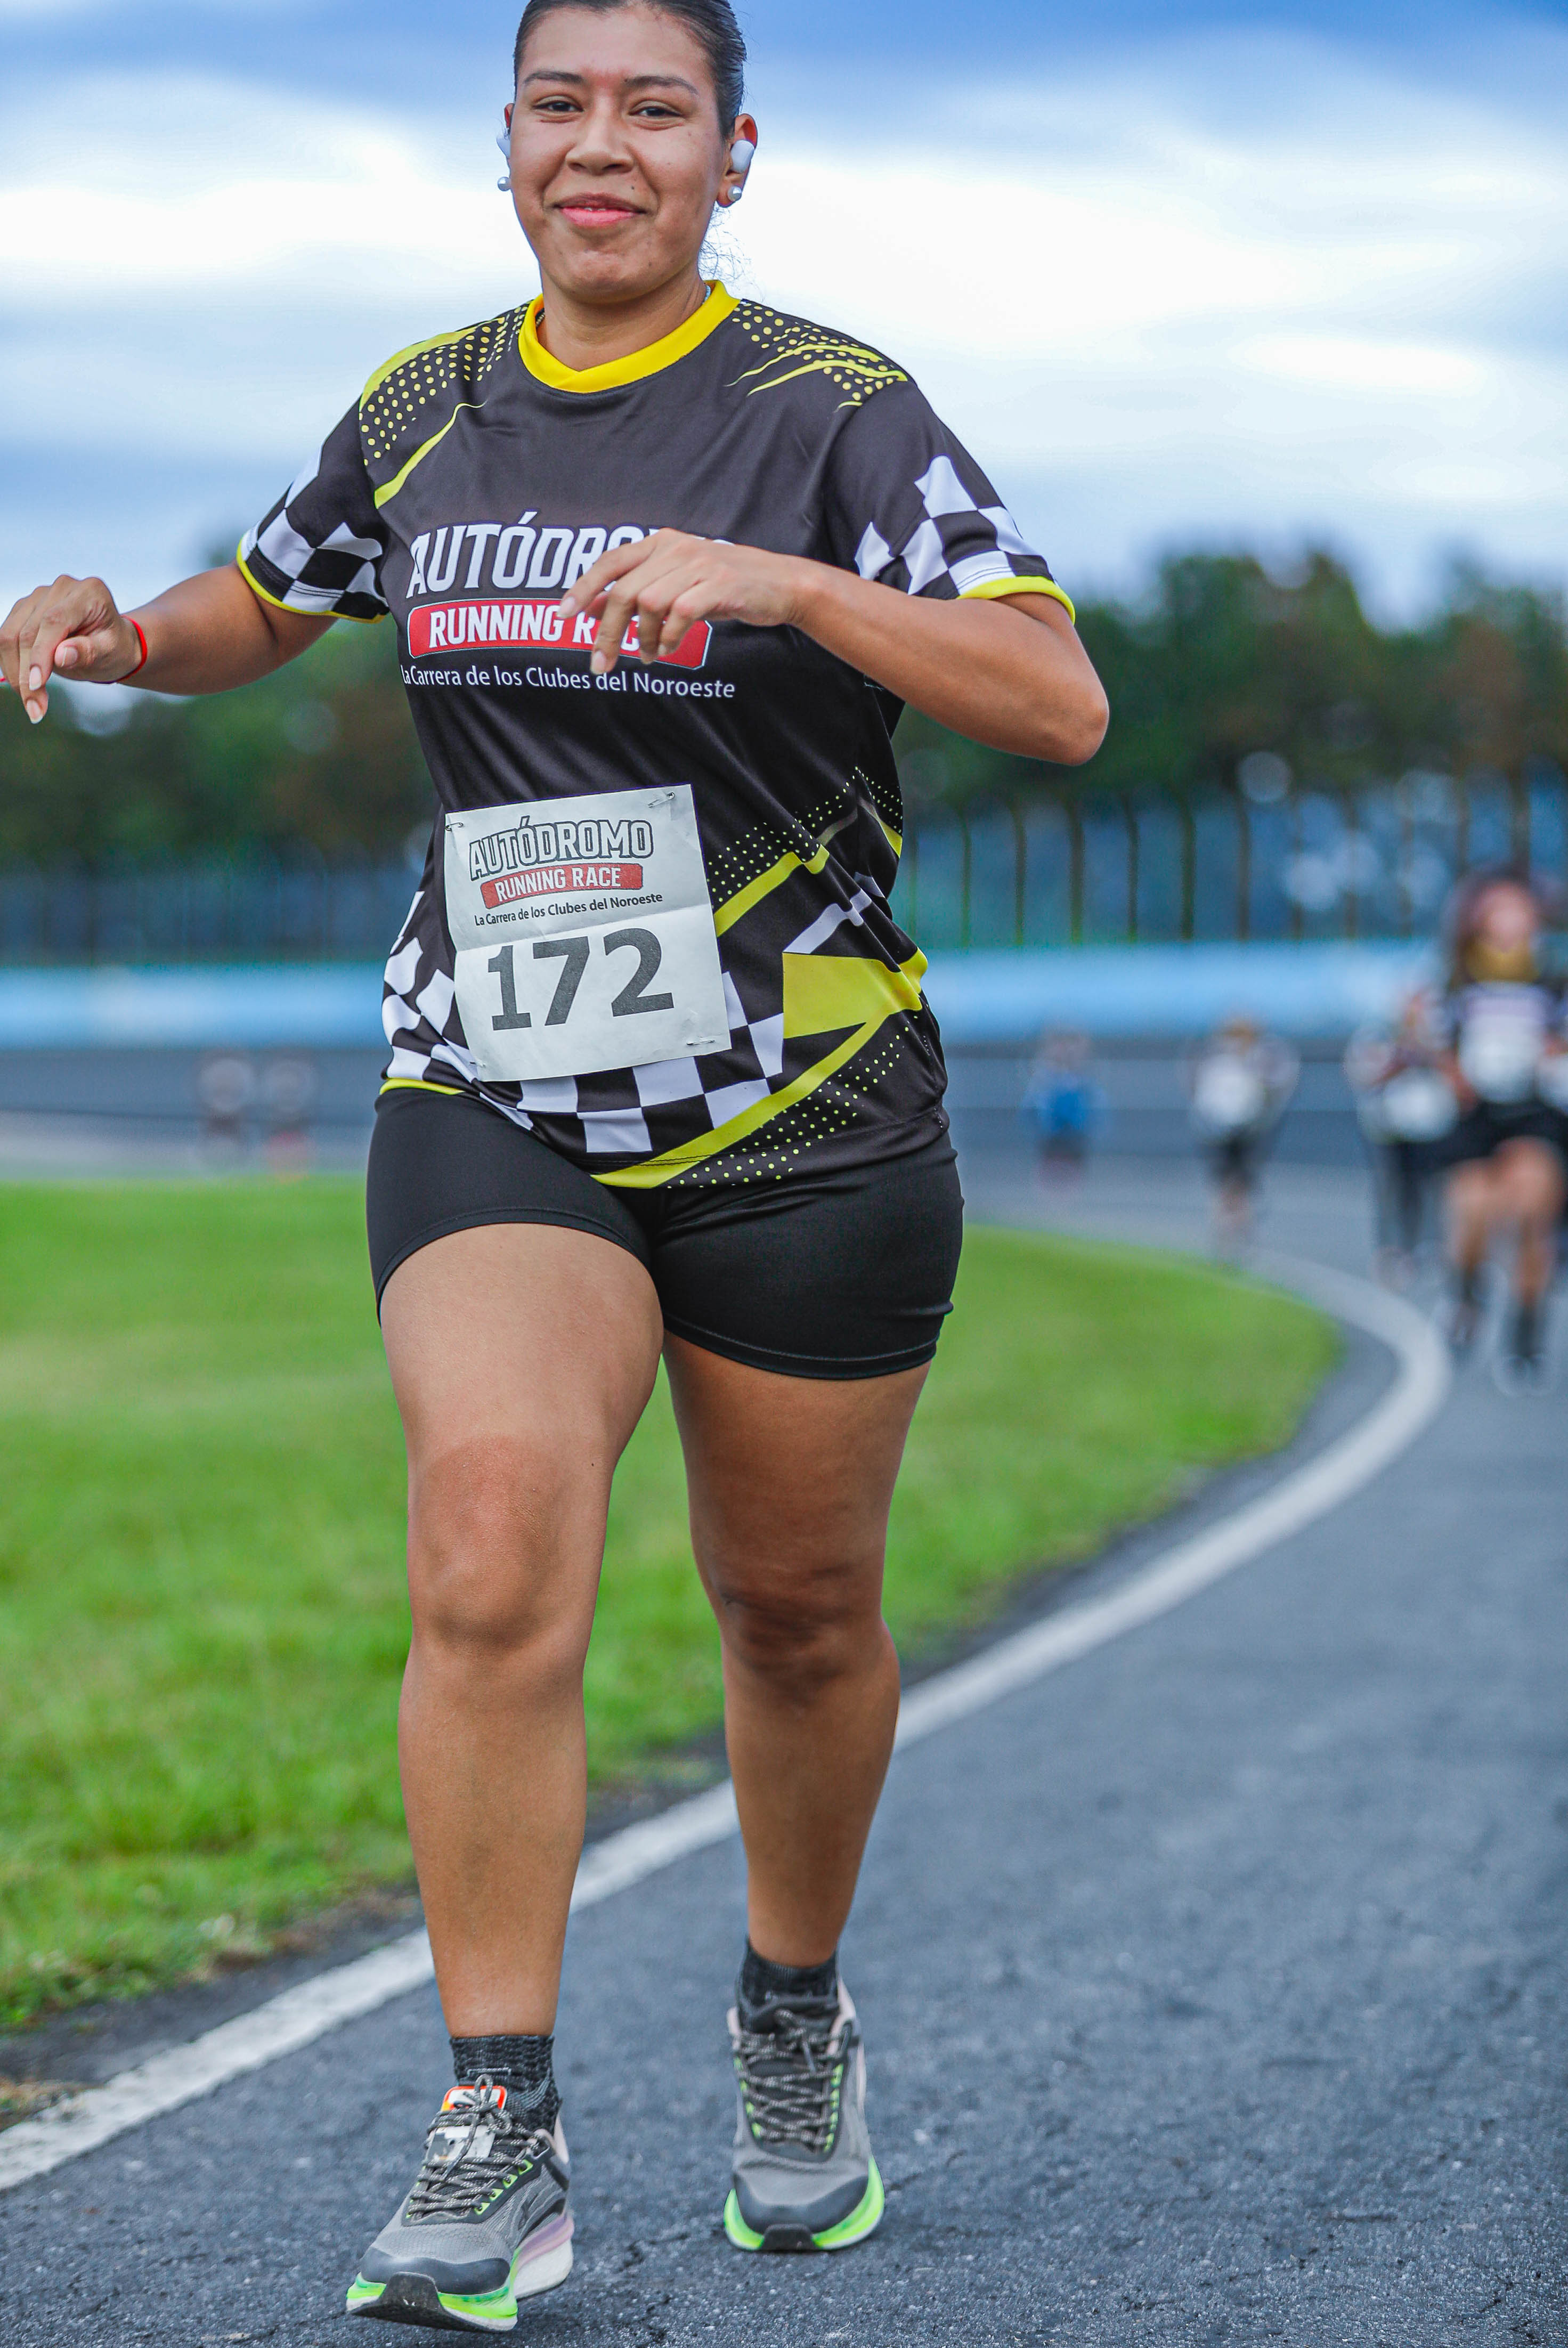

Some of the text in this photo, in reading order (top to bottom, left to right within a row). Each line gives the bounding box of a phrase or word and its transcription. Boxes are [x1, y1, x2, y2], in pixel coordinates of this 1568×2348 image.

[429, 604, 565, 648] RUNNING
[410, 665, 461, 686] Carrera
[466, 665, 491, 686] de
[493, 665, 523, 686] los
[525, 667, 590, 689] Clubes
[595, 671, 627, 692] del
[633, 672, 735, 698] Noroeste
[469, 815, 654, 881] AUTÓDROMO
[494, 866, 622, 903] RUNNING RACE
[474, 893, 663, 926] La Carrera de los Clubes del Noroeste
[488, 928, 675, 1031] 172
